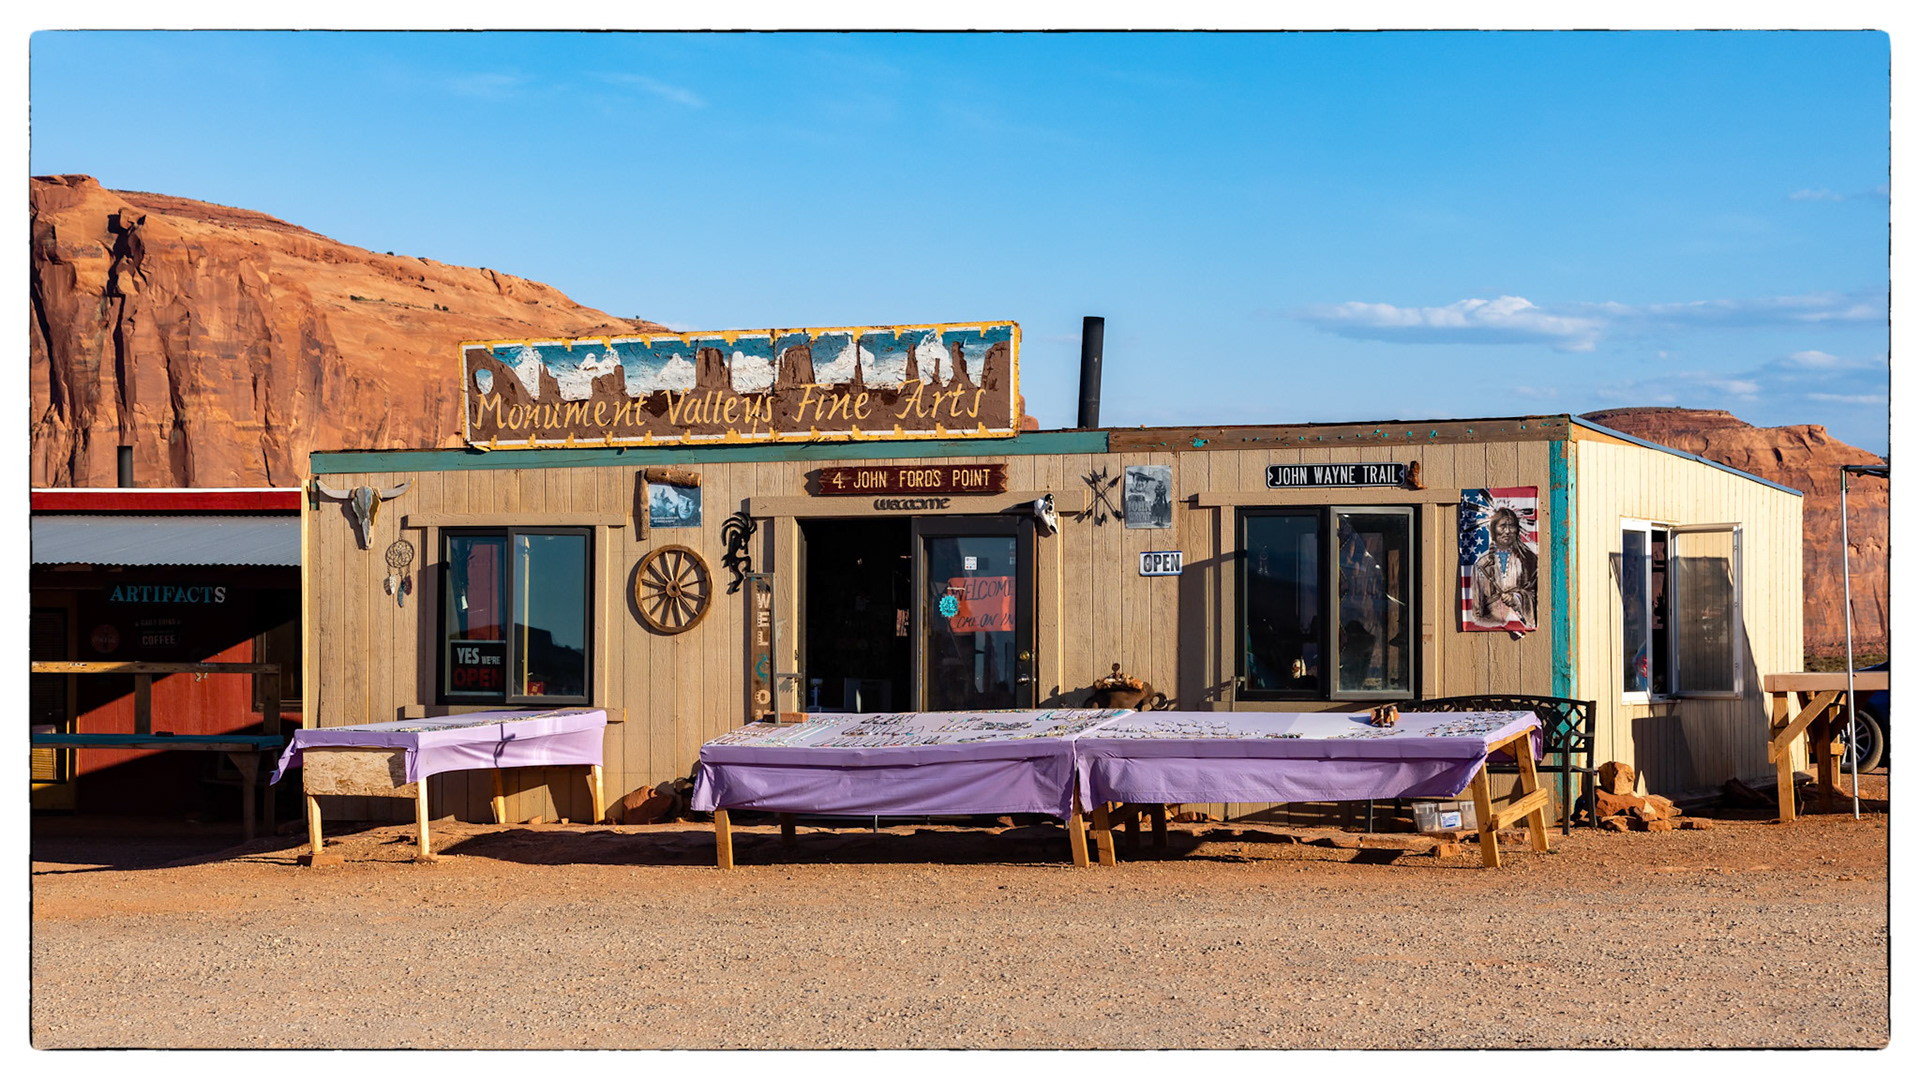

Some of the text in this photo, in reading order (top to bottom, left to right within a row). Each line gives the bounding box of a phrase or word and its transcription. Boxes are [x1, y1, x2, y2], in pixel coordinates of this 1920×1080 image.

[472, 391, 648, 430] Monument
[791, 383, 872, 423] Fine
[894, 378, 987, 419] Arts
[832, 471, 846, 489] 4.
[853, 471, 887, 488] JOHN
[952, 469, 991, 487] POINT
[1274, 465, 1398, 485] JOHN WAYNE TRAIL
[1143, 554, 1180, 573] OPEN
[109, 585, 226, 604] ARTIFACTS
[142, 634, 176, 646] COFFEE
[456, 647, 501, 665] YES WE'RE
[453, 667, 504, 688] OPEN
